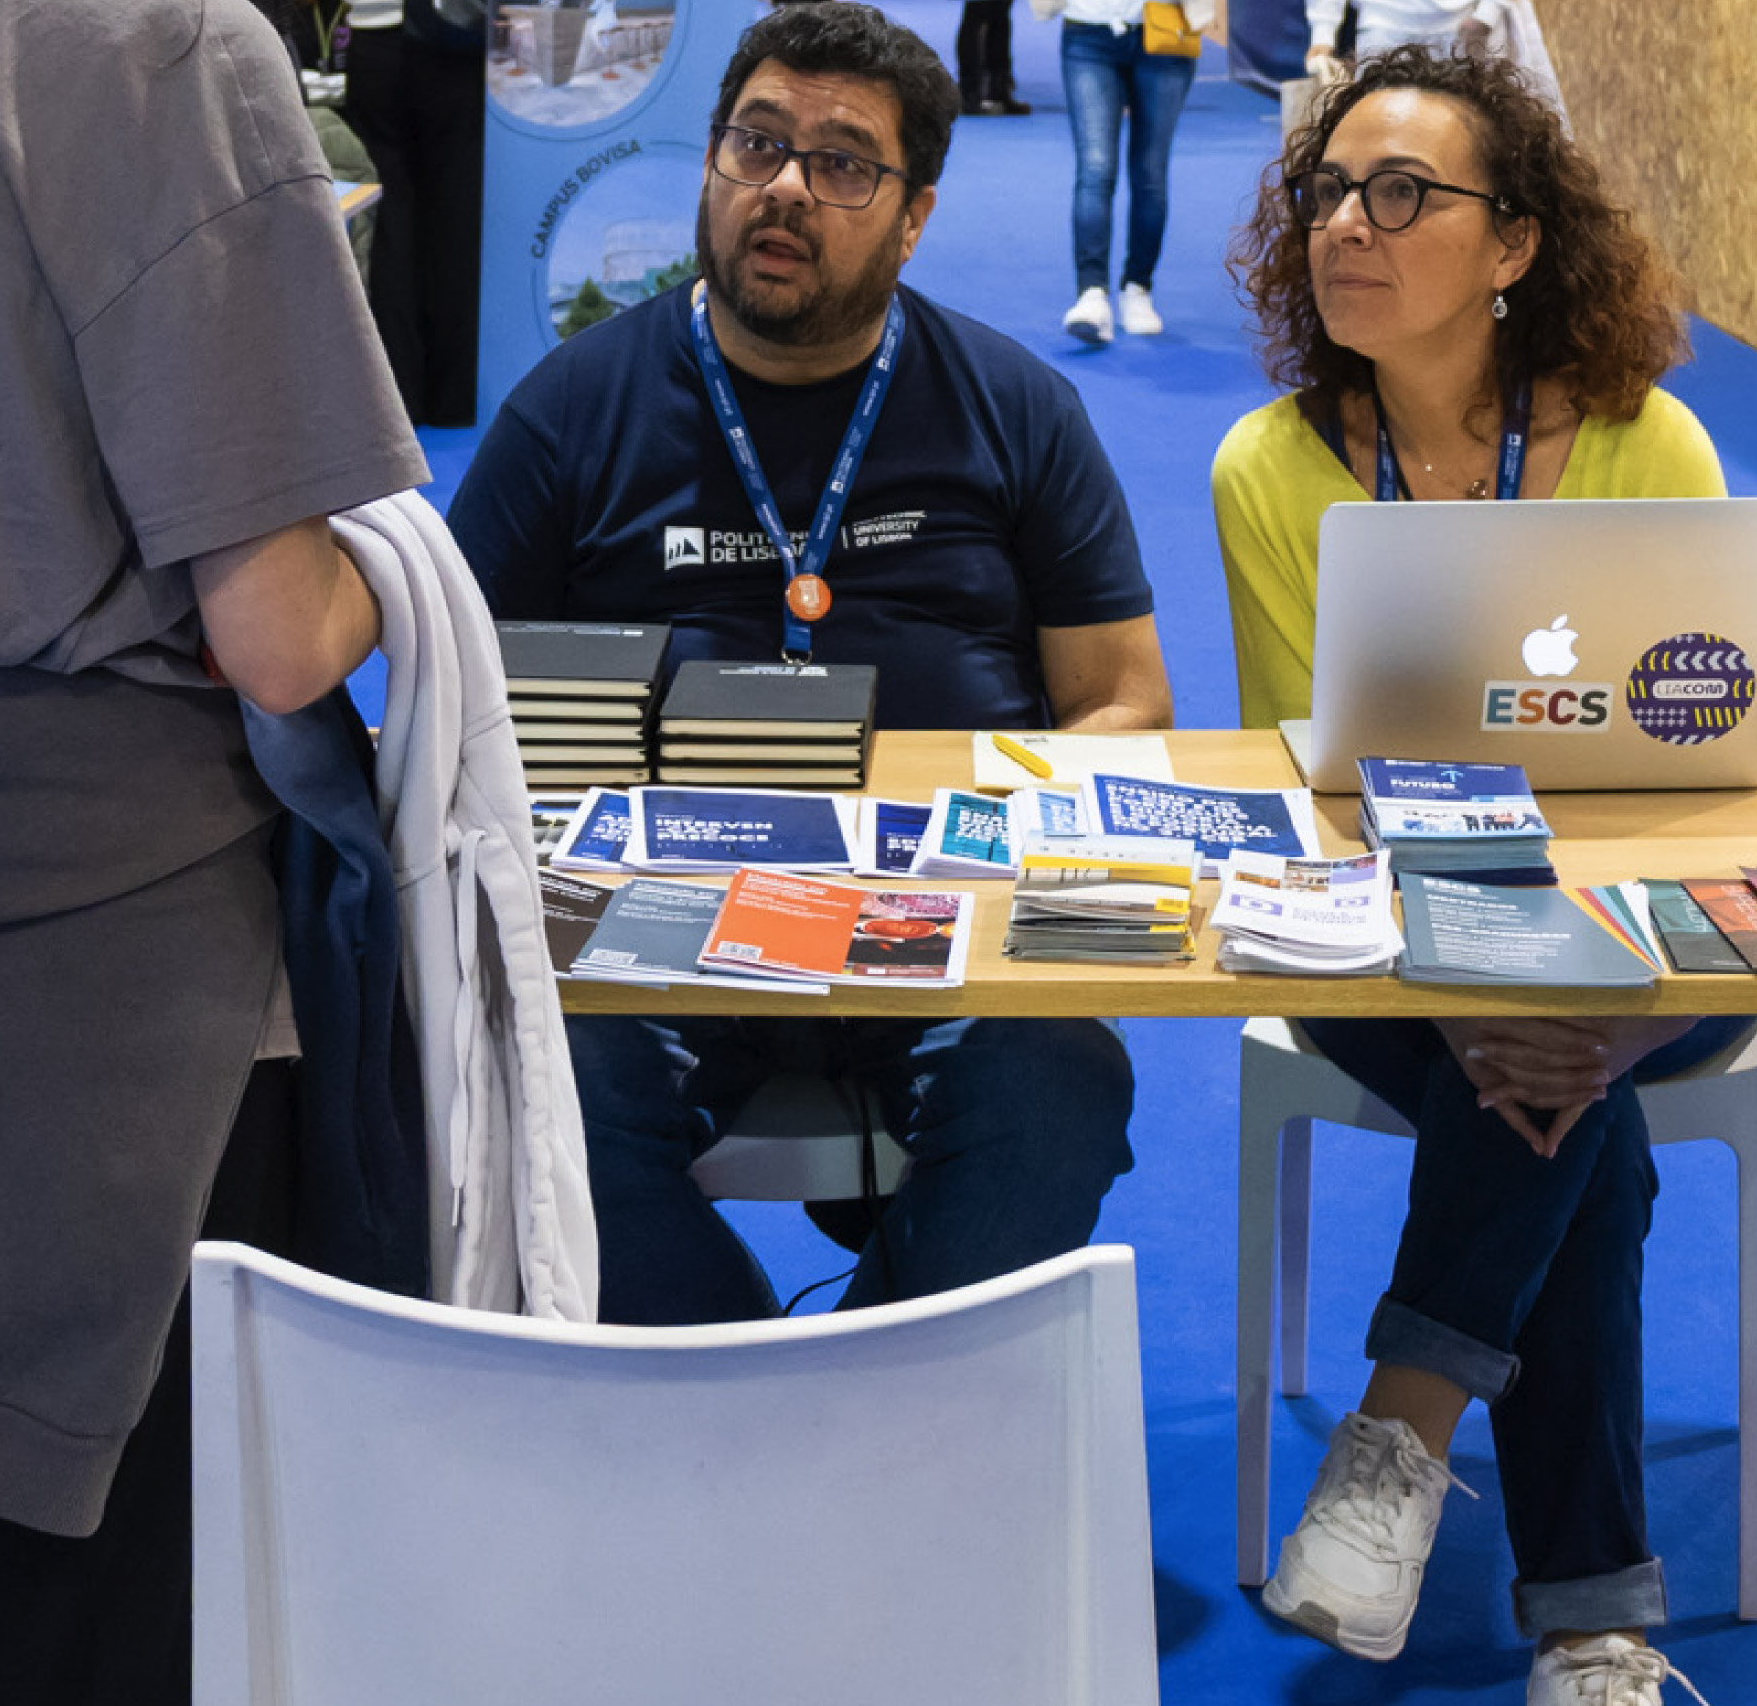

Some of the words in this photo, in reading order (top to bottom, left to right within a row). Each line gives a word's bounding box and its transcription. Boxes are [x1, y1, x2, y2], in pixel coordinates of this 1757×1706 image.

[531, 179, 580, 260] CAMPUS
[575, 139, 642, 183] BOVISA
[712, 547, 737, 563] DE
[1658, 683, 1724, 696] LIACOM
[1486, 688, 1609, 726] ESCS
